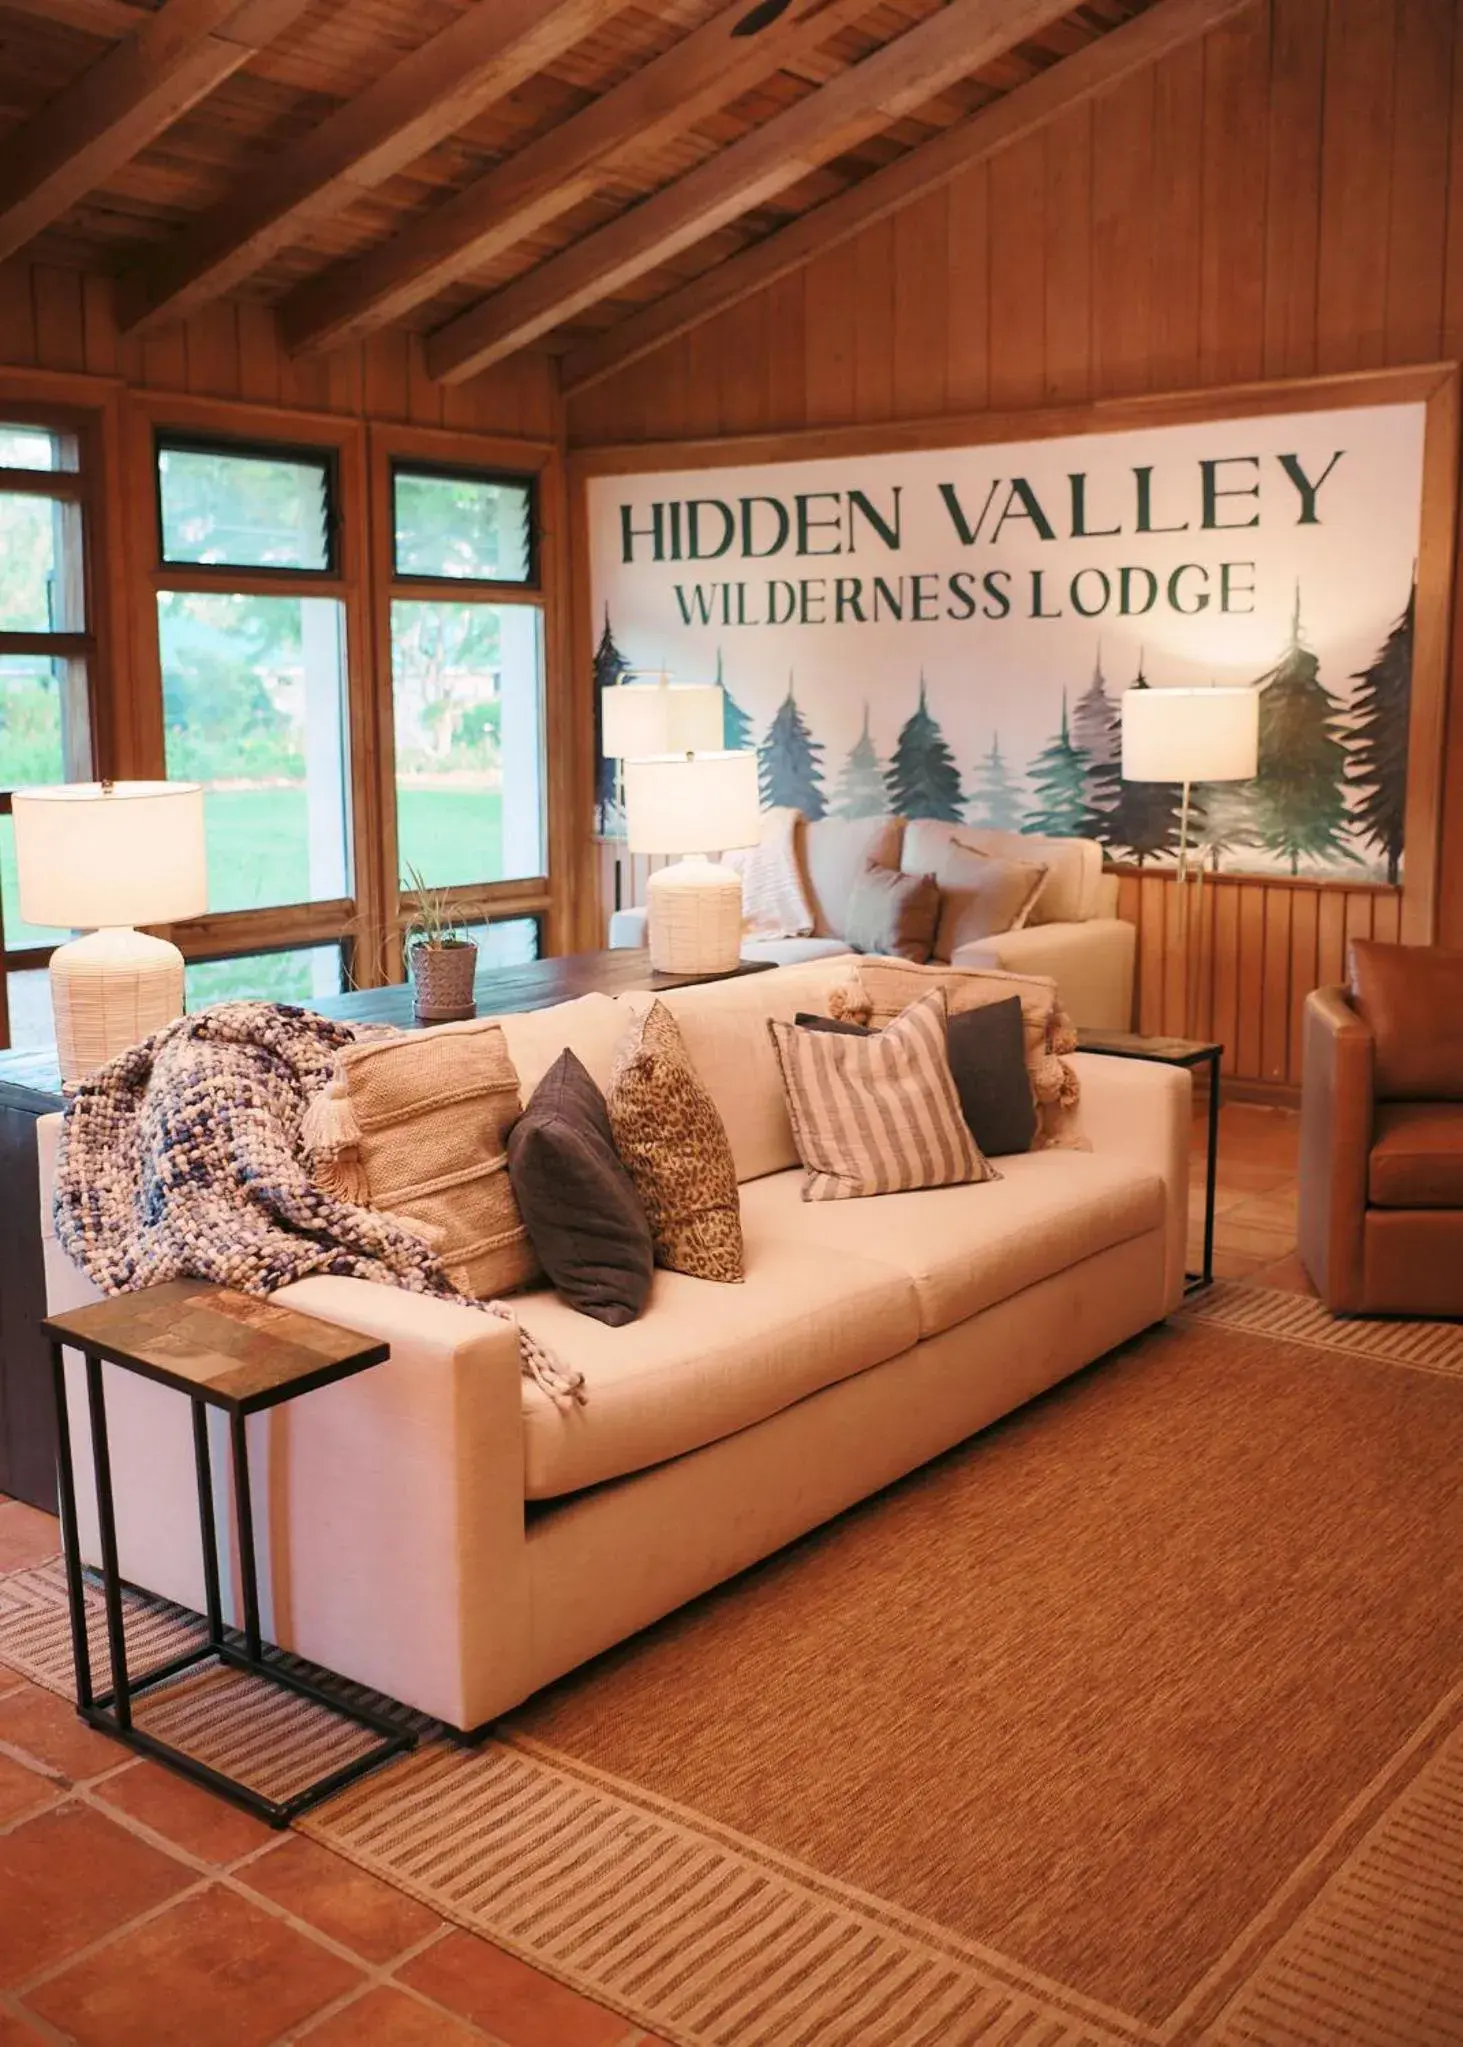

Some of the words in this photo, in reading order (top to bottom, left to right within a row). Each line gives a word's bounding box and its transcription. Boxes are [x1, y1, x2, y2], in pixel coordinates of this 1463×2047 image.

[618, 485, 903, 565] HIDDEN
[936, 450, 1346, 547] VALLEY
[673, 569, 1012, 627] WILDERNESS
[1026, 562, 1257, 620] LODGE
